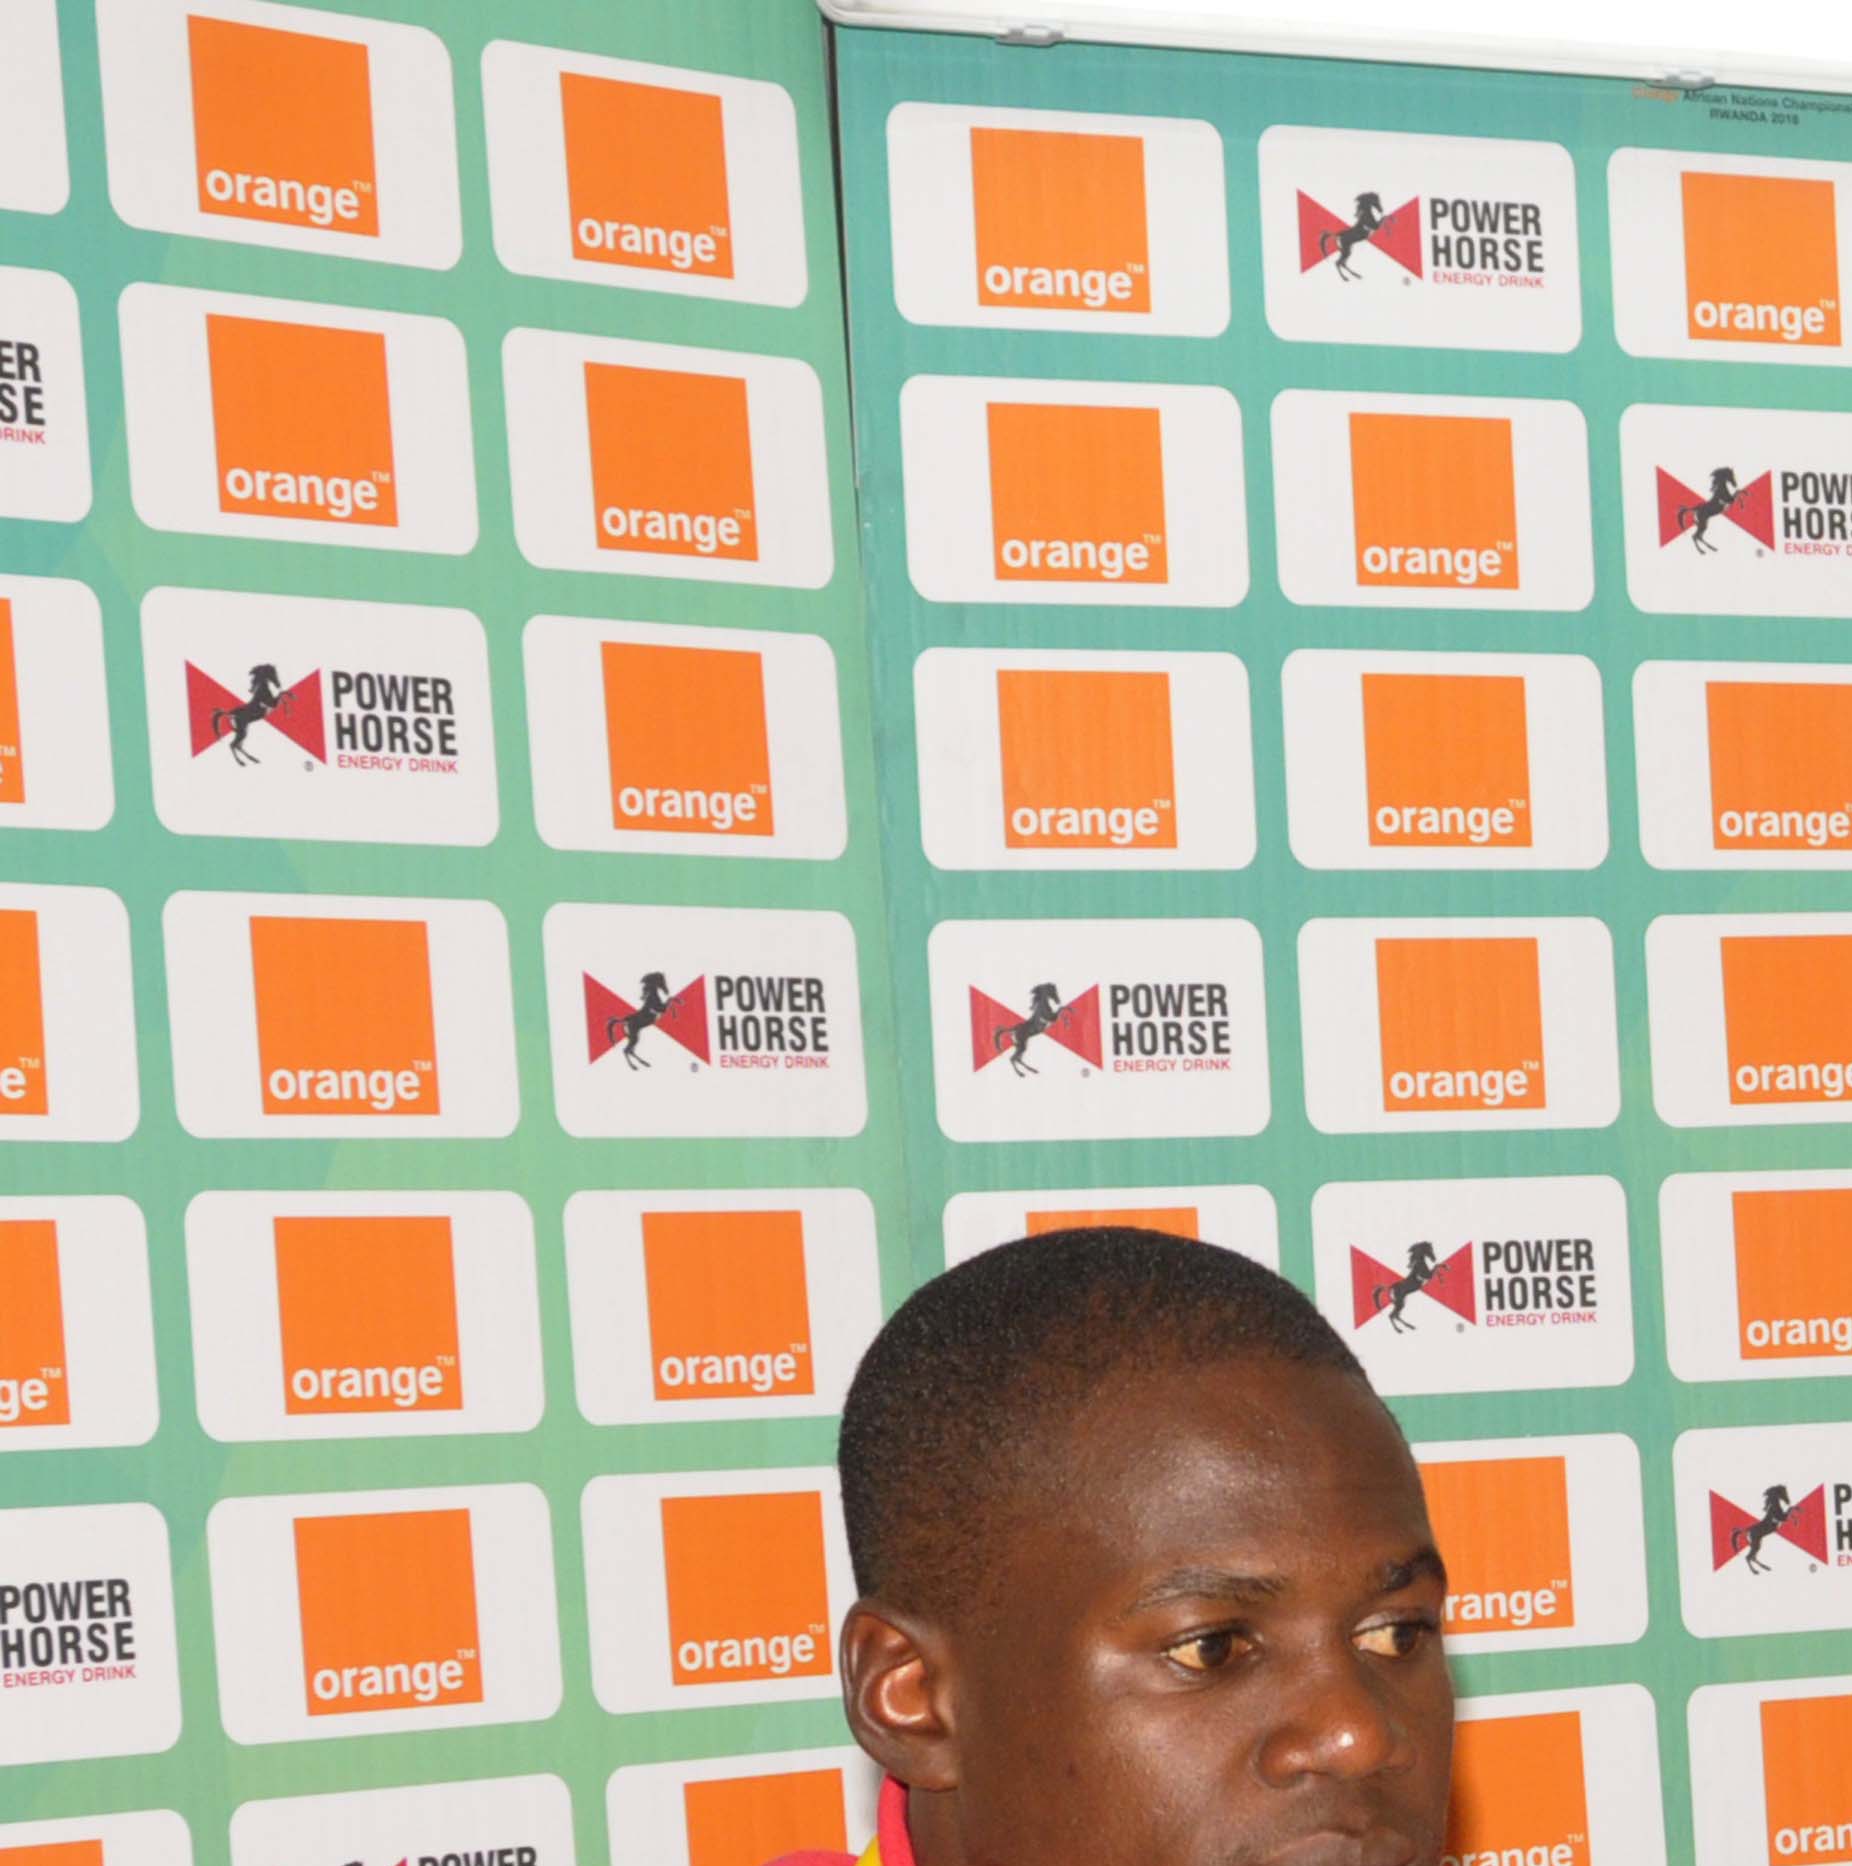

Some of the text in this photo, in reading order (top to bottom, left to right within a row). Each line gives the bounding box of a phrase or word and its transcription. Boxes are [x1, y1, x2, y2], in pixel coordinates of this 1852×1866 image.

[1732, 93, 1778, 108] Nations
[1431, 199, 1541, 235] POWER
[1432, 235, 1543, 272] HORSE
[333, 672, 453, 714] POWER
[335, 713, 457, 755] HORSE
[339, 755, 455, 771] ENERGY DRINK
[716, 976, 825, 1012] POWER
[1111, 984, 1227, 1018] POWER
[718, 1015, 828, 1052] HORSE
[1113, 1021, 1230, 1055] HORSE
[1113, 1058, 1231, 1073] ENERGY DRINK
[1483, 1239, 1594, 1274] POWER
[1485, 1275, 1596, 1310] HORSE
[1488, 1313, 1594, 1325] ENERGY DRINK
[0, 1579, 131, 1624] POWER
[1442, 1580, 1556, 1626] range
[1, 1622, 135, 1668] HORSE
[4, 1667, 133, 1687] ENERGY DRINK
